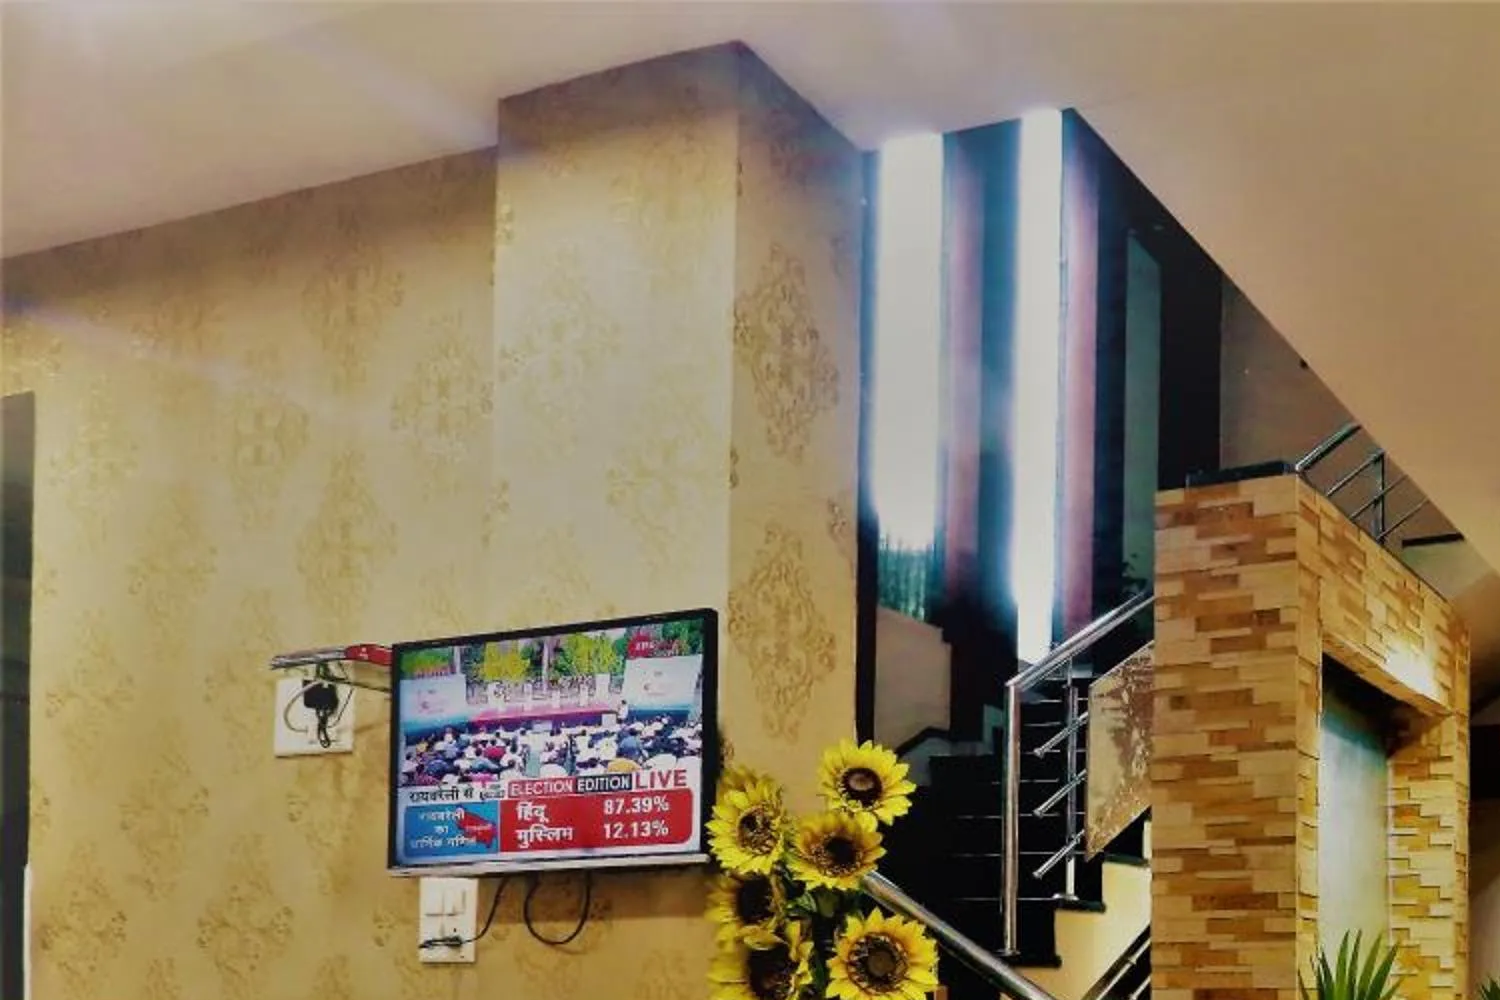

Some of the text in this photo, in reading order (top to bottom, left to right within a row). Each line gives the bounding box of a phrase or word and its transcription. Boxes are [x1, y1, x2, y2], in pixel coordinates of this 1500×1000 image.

[511, 782, 574, 796] ELECTION
[577, 775, 631, 791] EDITION
[636, 769, 687, 788] LIVE
[604, 796, 669, 815] 87.39%
[604, 820, 669, 839] 12.13%
